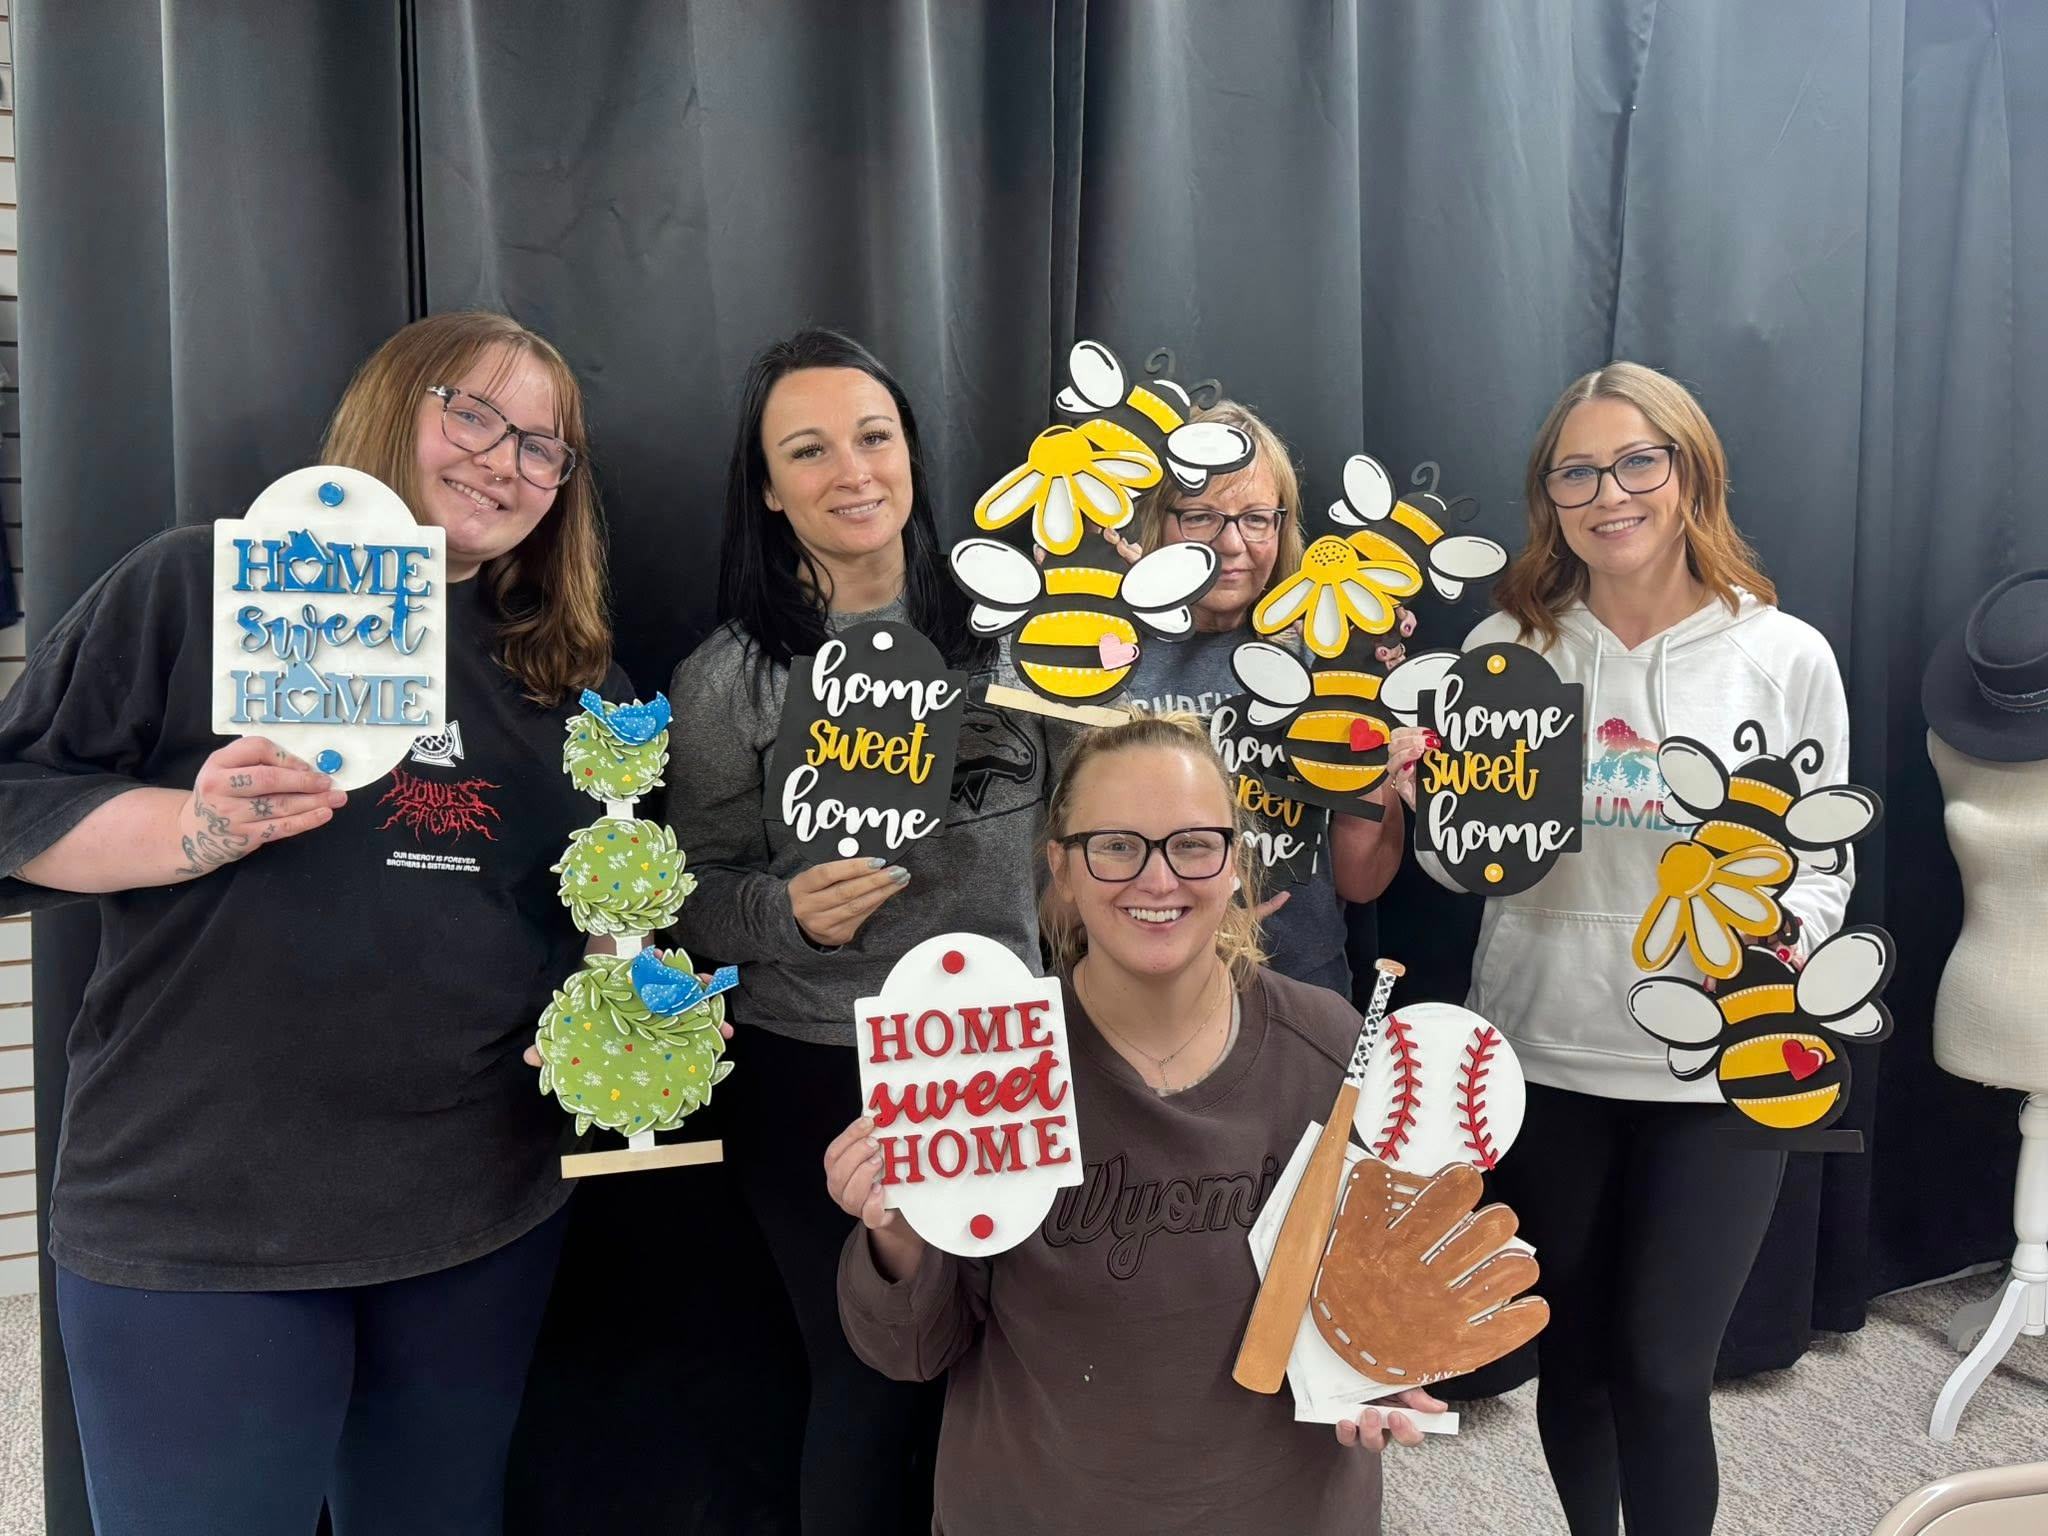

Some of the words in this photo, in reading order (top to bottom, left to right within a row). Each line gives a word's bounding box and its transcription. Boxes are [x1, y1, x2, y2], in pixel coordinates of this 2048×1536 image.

[236, 590, 428, 663] sweet
[812, 639, 962, 720] home
[1434, 673, 1576, 752] home
[806, 719, 936, 784] sweet
[1423, 739, 1540, 801] sweet
[782, 764, 941, 850] home
[1428, 790, 1576, 865] home
[386, 858, 421, 868] BROTHERS
[427, 862, 455, 871] SISTERS
[393, 851, 407, 859] OUR
[408, 852, 435, 861] ENERGY
[443, 856, 476, 864] FOREVER
[866, 999, 1054, 1064] HOME
[868, 1050, 1069, 1128] sweet
[877, 1115, 1072, 1186] HOME
[1042, 1152, 1279, 1280] Wyomi
